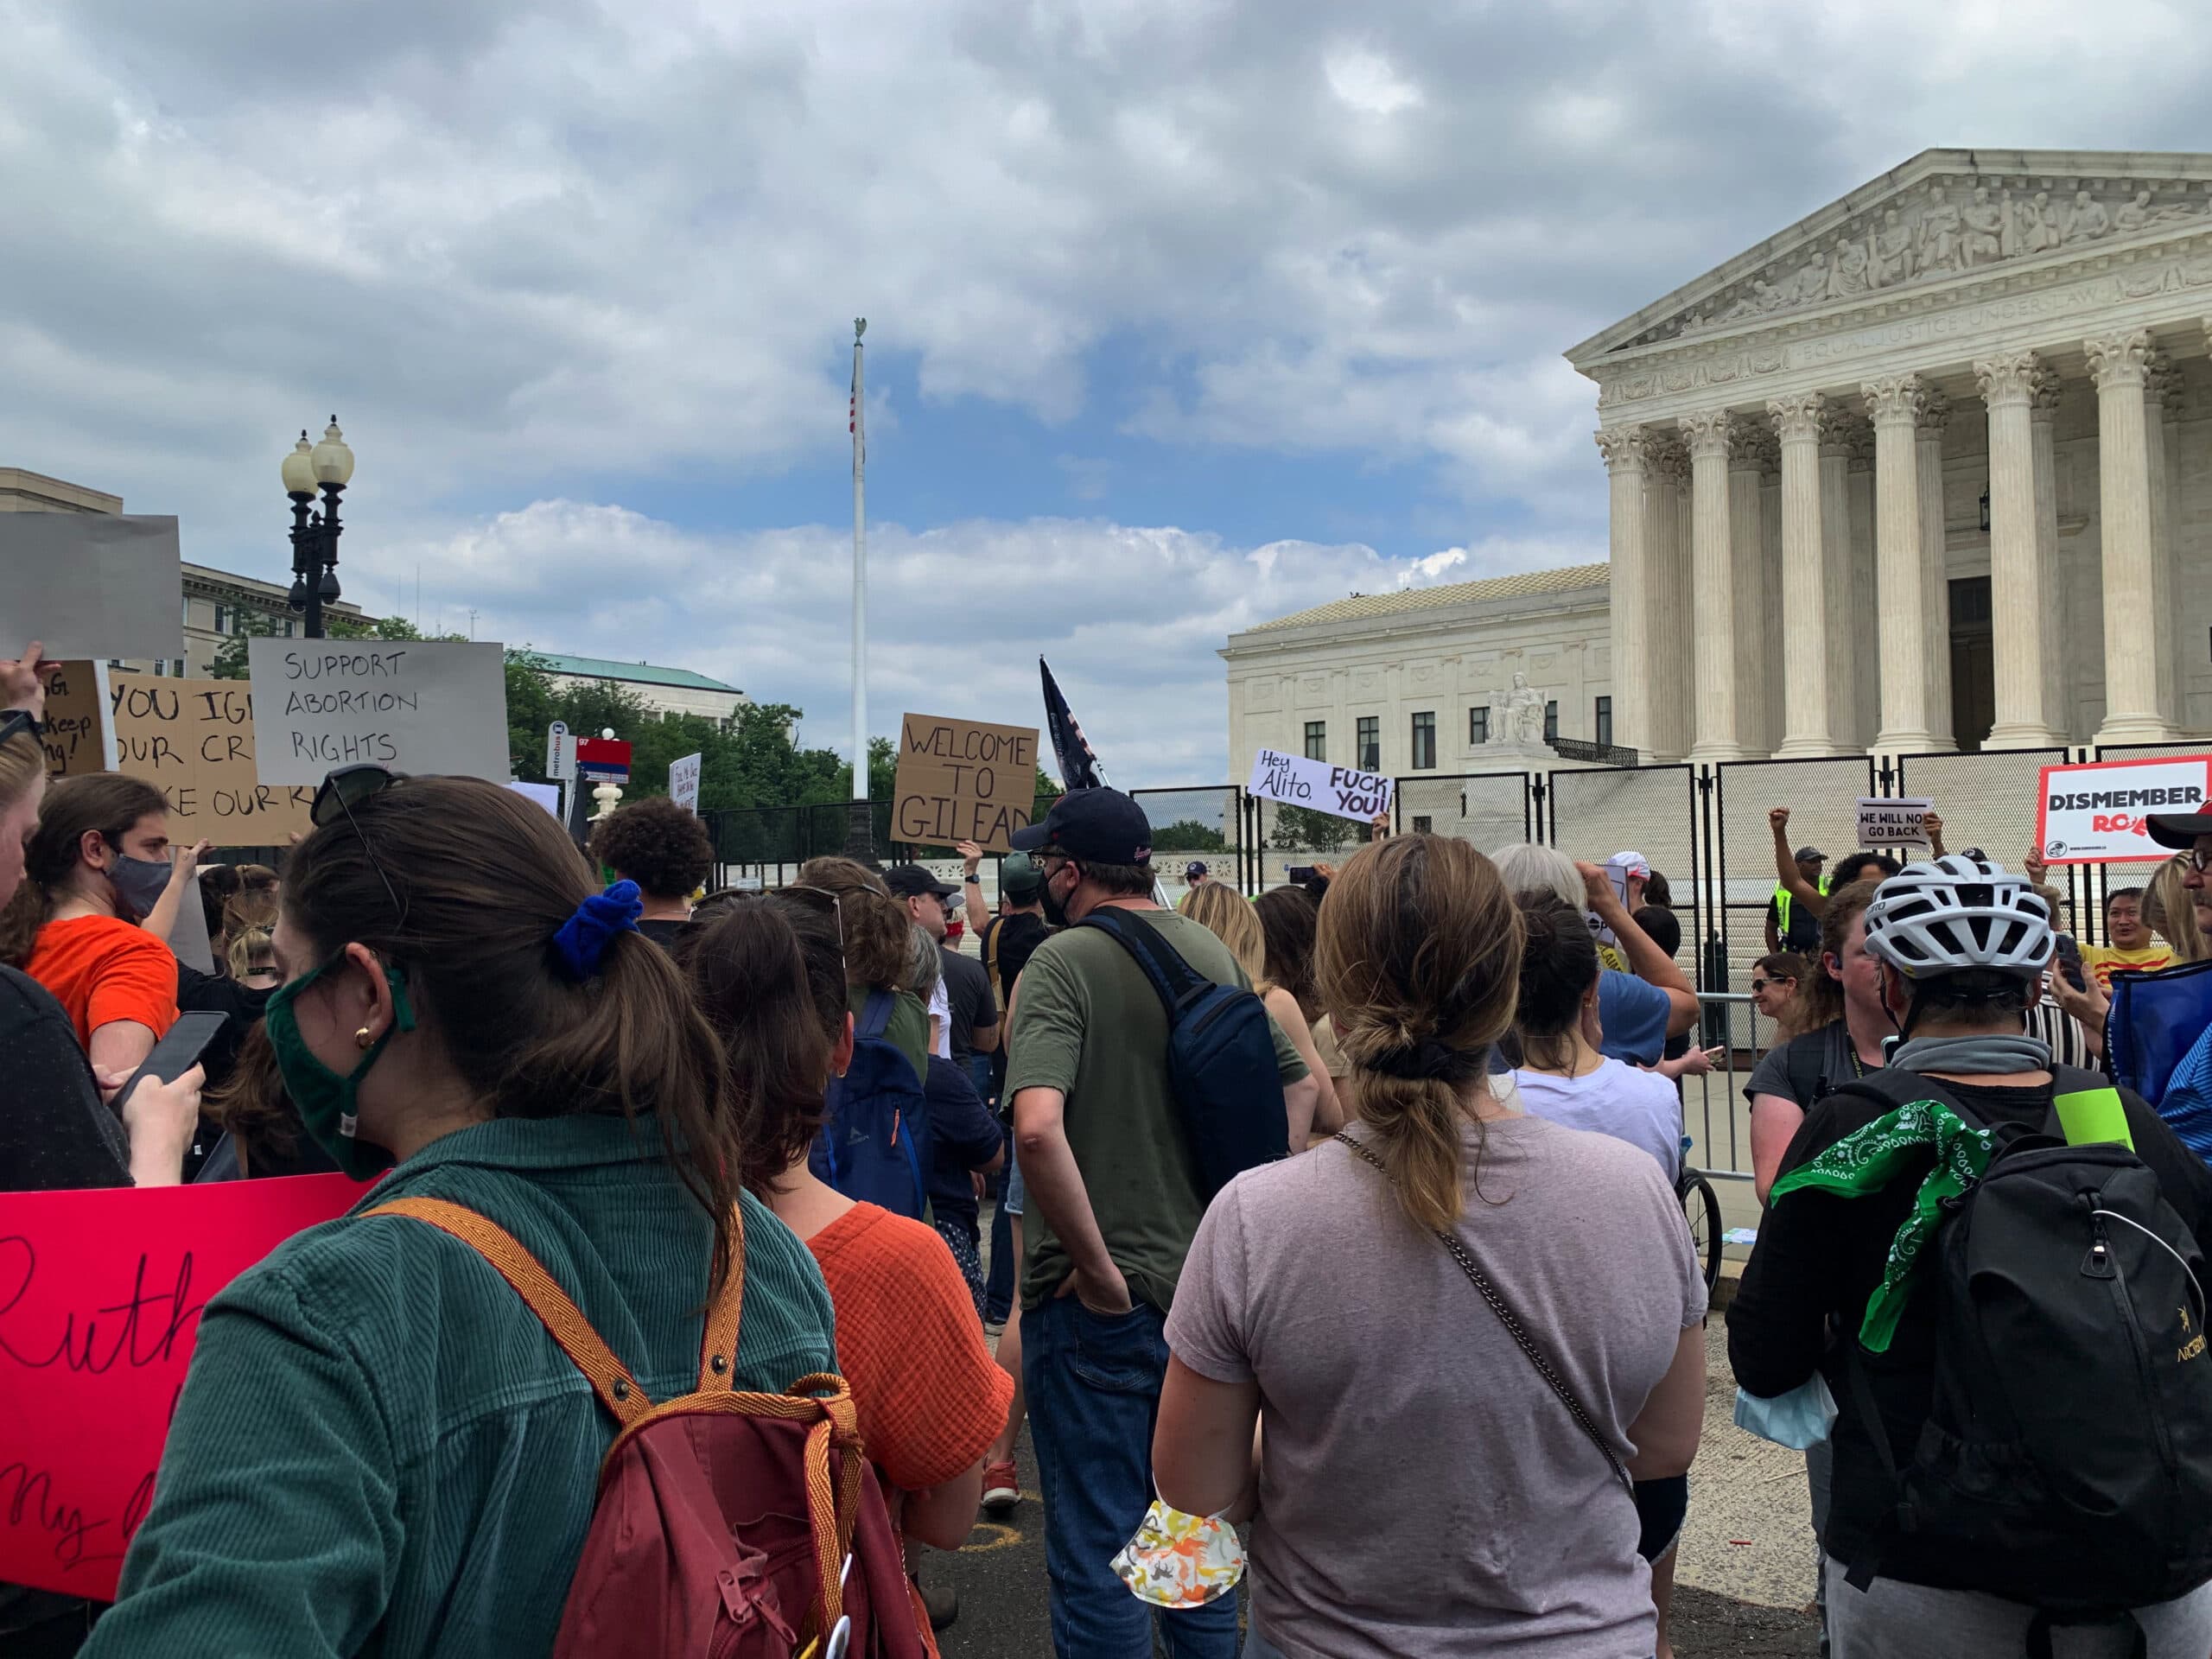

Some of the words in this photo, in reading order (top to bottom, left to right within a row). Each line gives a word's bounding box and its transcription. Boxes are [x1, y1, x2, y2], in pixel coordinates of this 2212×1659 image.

[285, 652, 406, 679] SUPPORT
[194, 691, 253, 724] IG
[285, 690, 417, 715] ABORTION
[201, 734, 255, 761] CR
[292, 732, 397, 762] RIGHTS
[553, 736, 562, 777] metrobus
[906, 722, 1033, 766] WELCOME
[1262, 750, 1290, 772] Hey
[943, 764, 994, 798] TO
[1258, 769, 1312, 801] Alito,
[1330, 766, 1388, 798] FUCK
[213, 785, 279, 817] OUR
[2049, 786, 2203, 811] DISMEMBER
[899, 795, 1031, 848] GILEAD
[1860, 813, 1876, 823] WE
[1879, 813, 1904, 823] WILL
[1906, 814, 1923, 823] NO
[1868, 827, 1885, 836] GO
[1887, 827, 1920, 836] BACK
